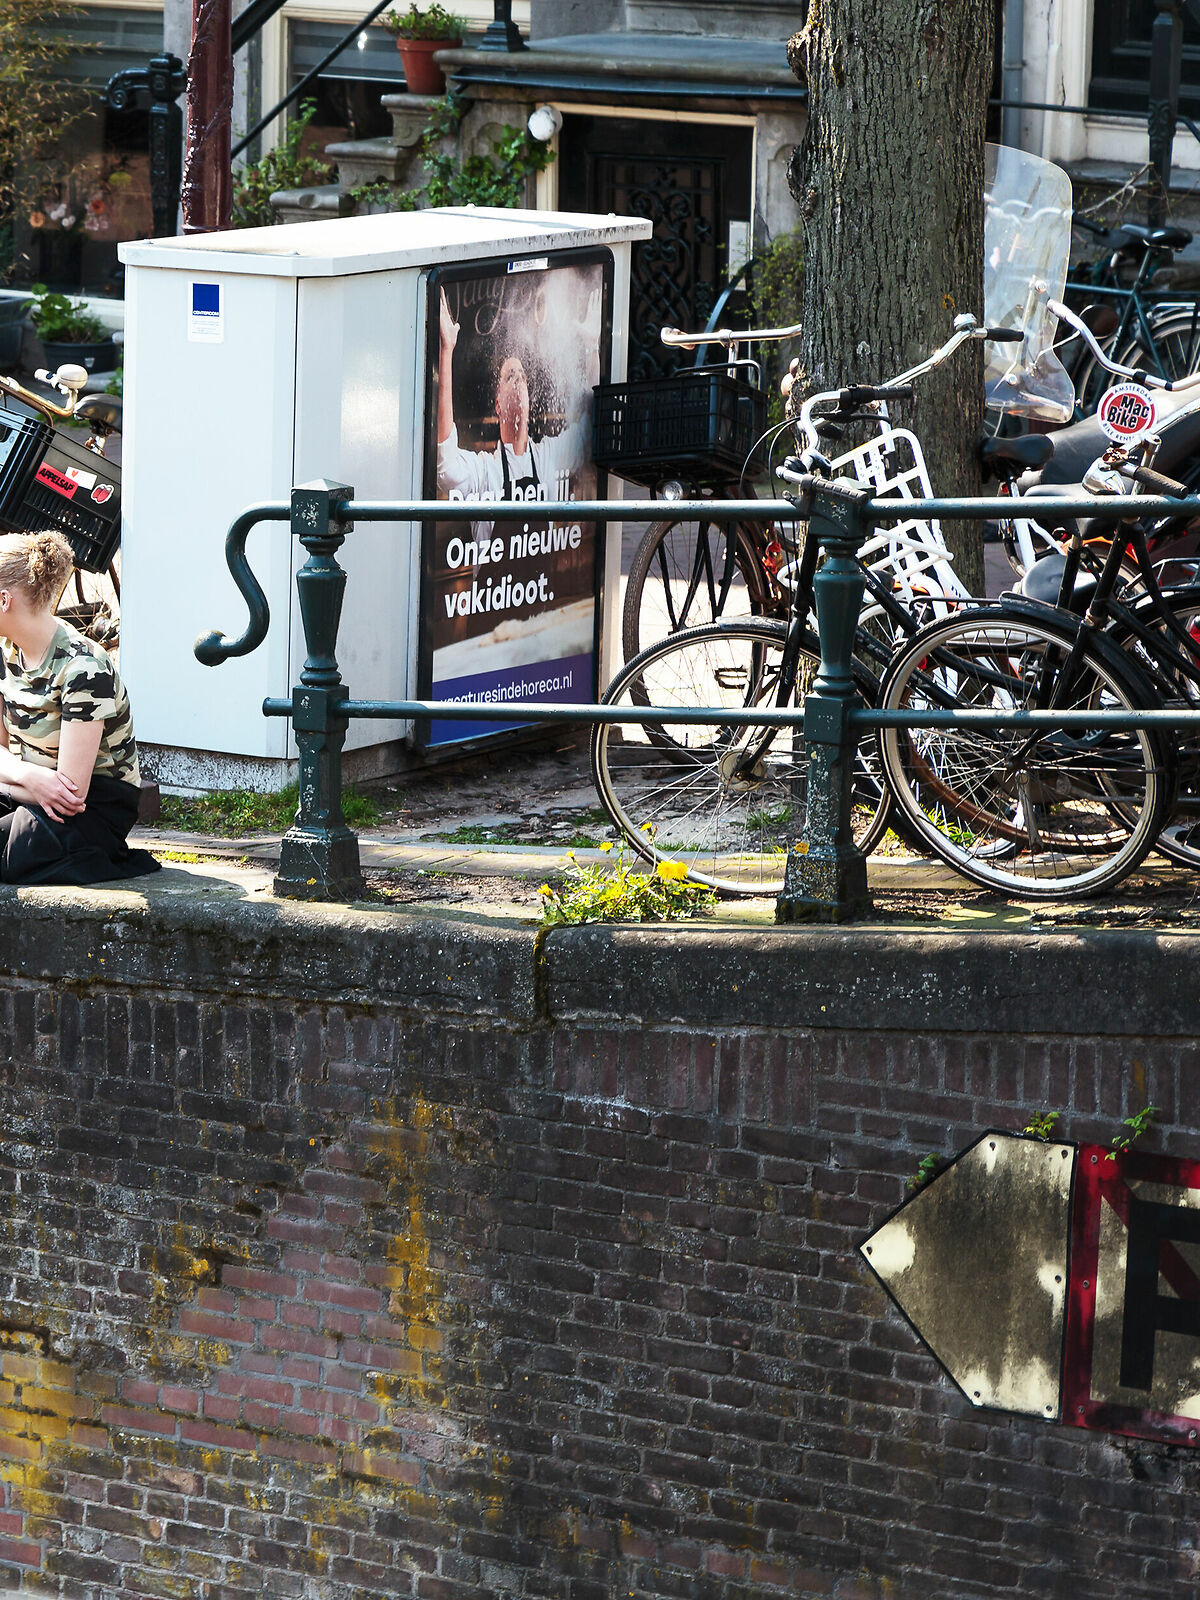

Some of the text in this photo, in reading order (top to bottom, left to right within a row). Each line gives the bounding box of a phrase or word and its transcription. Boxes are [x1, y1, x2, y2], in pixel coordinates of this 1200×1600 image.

[1114, 385, 1152, 402] AMSTERDAM
[1107, 406, 1137, 428] Bike
[1120, 395, 1150, 418] Mac
[39, 468, 75, 491] APPELSAP
[446, 523, 582, 569] Onze nieuwe
[444, 573, 554, 618] vakidioot.
[441, 670, 573, 703] aturesindehoreca.nl
